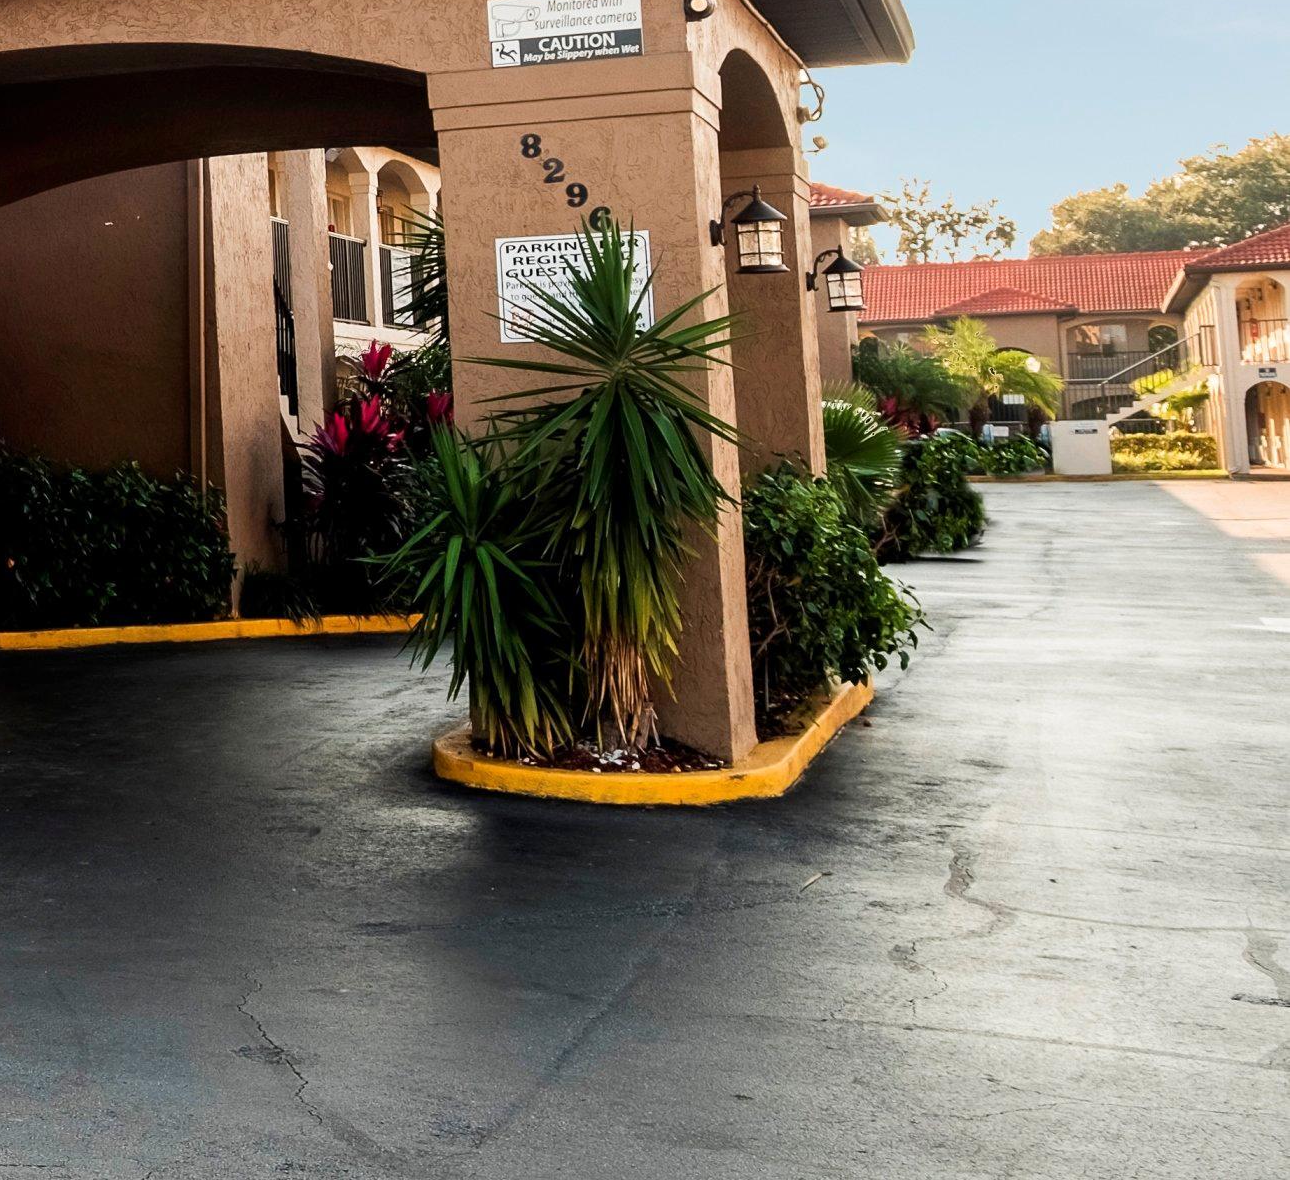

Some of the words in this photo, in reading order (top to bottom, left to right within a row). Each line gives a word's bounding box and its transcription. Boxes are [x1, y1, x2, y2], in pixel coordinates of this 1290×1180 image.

[534, 14, 594, 30] surveillance
[595, 11, 637, 25] cameras
[538, 32, 615, 52] CAUTION
[523, 53, 543, 63] May
[544, 52, 555, 61] be
[556, 48, 593, 60] Slippery
[595, 46, 619, 56] when
[620, 44, 639, 54] Wet
